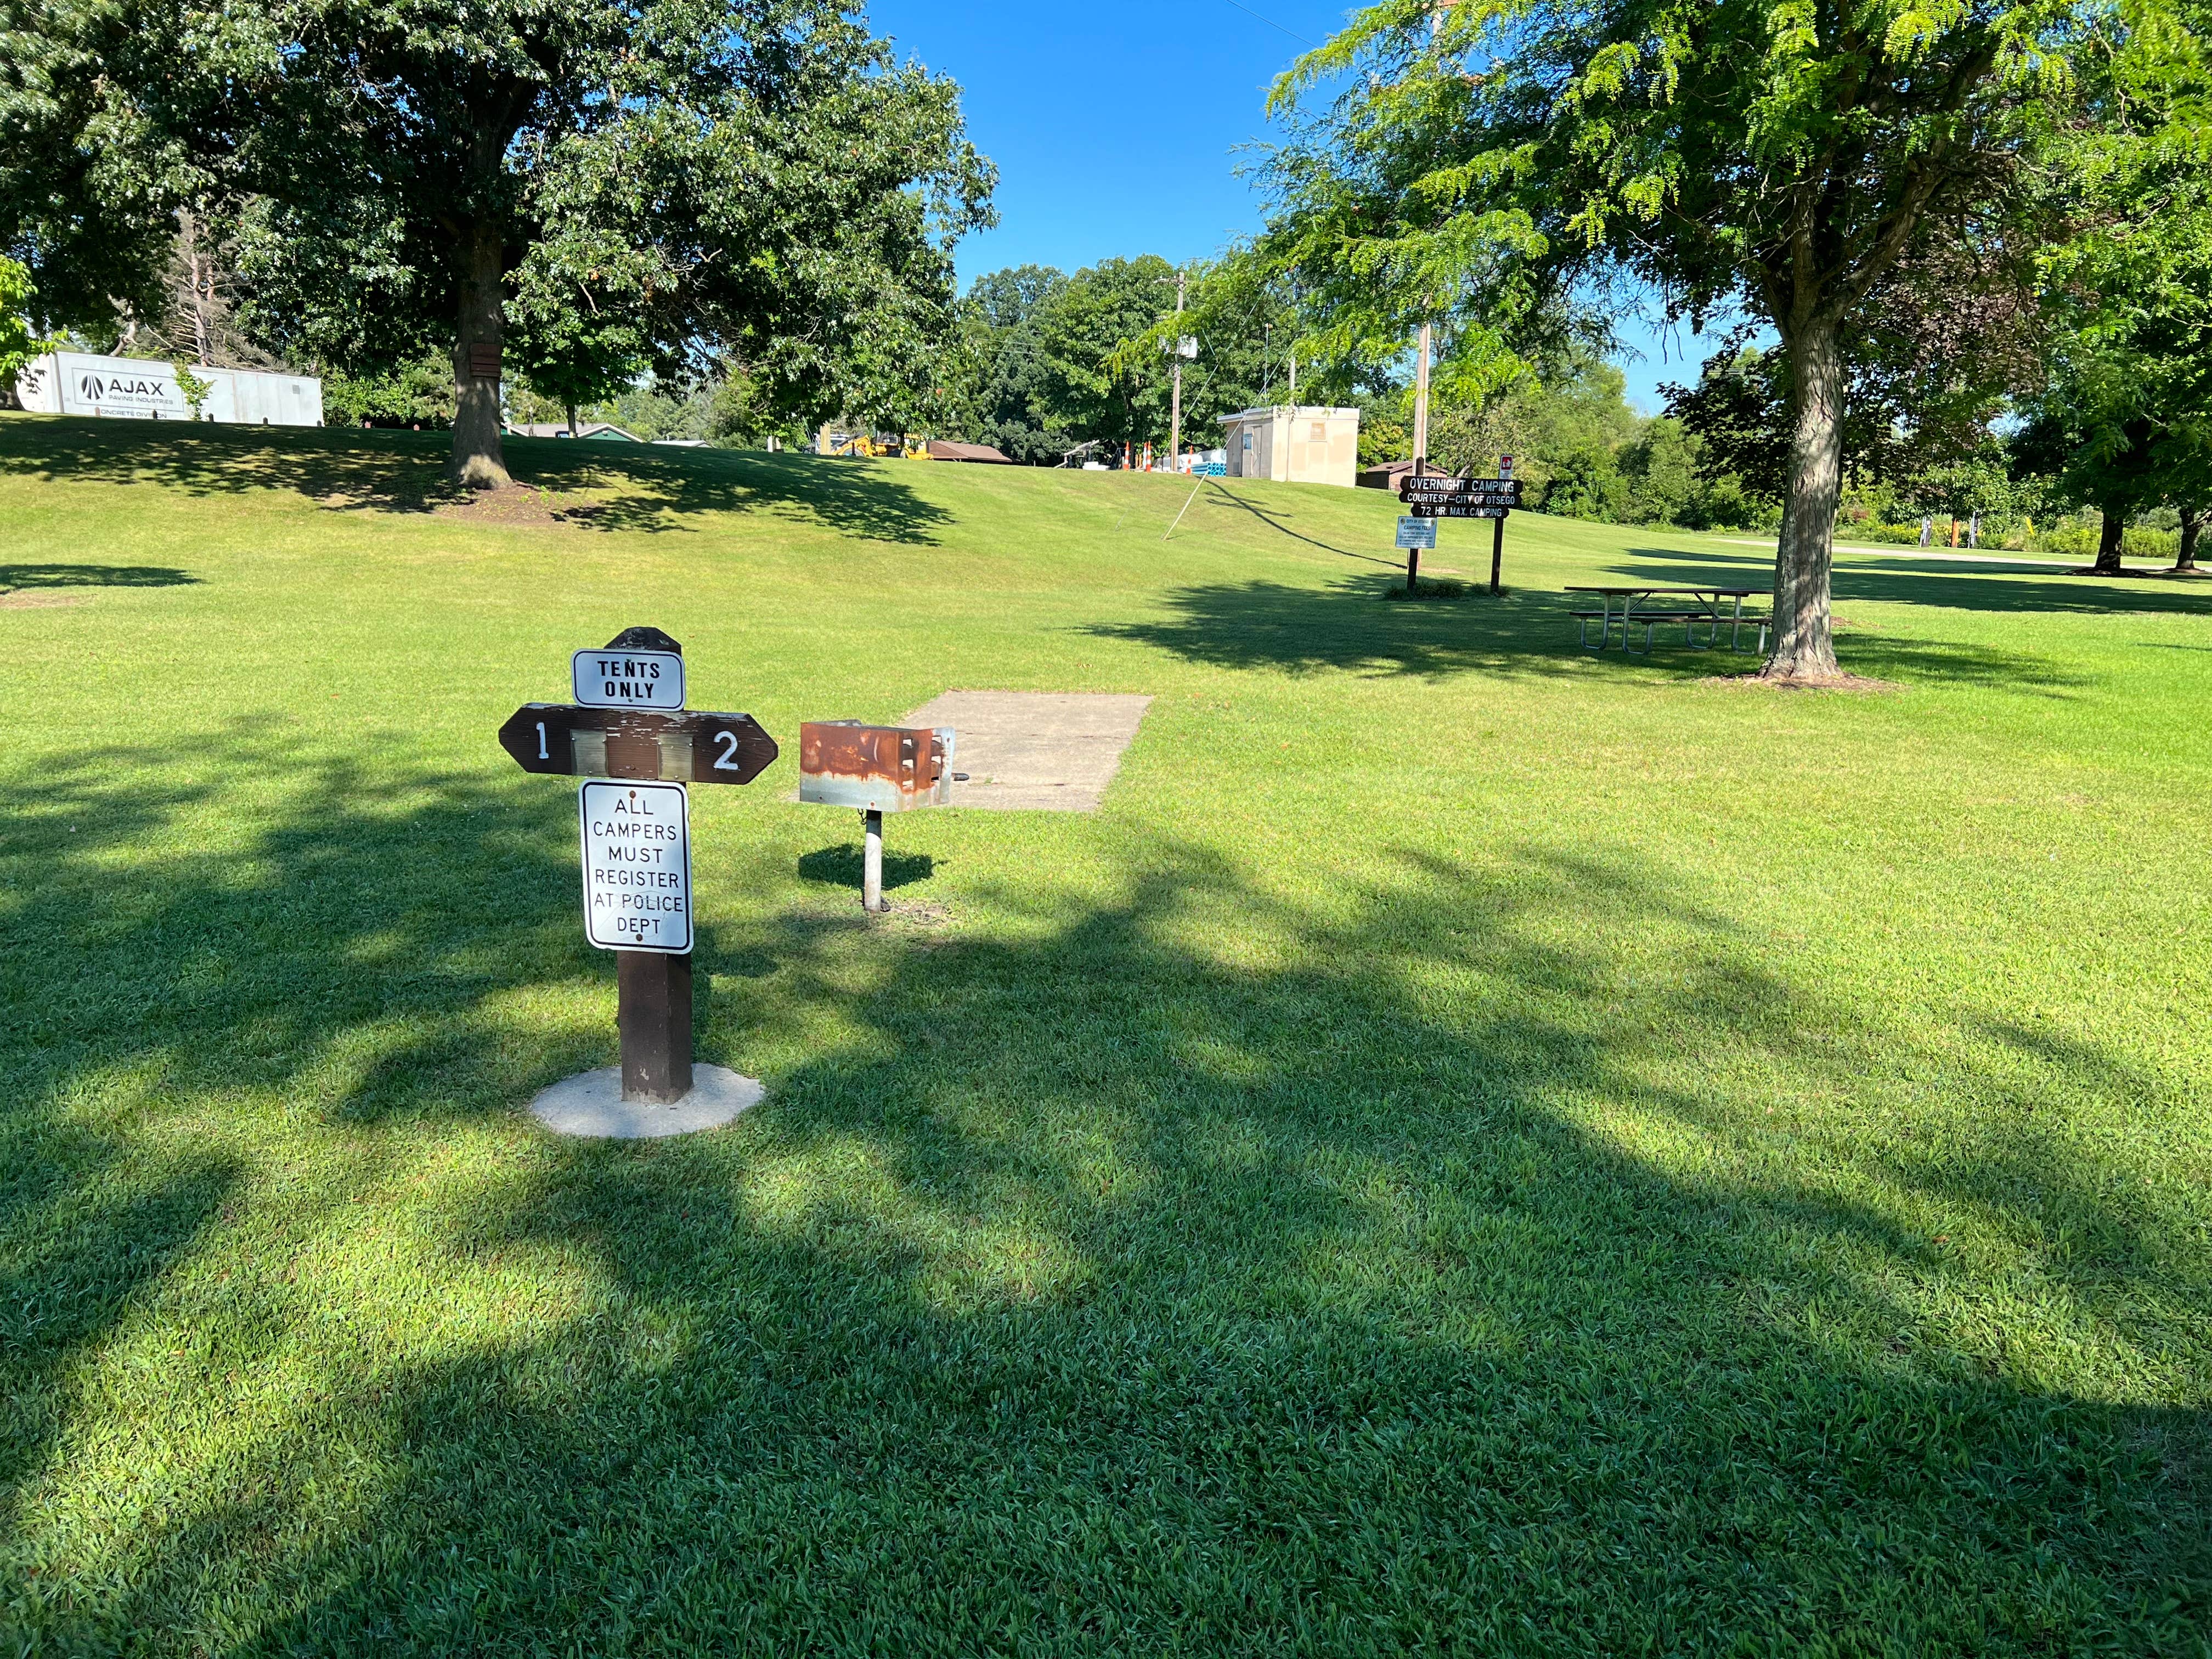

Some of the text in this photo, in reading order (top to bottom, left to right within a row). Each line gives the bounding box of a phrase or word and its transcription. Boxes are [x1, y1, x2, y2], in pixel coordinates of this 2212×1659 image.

[108, 379, 165, 396] AJAX
[1409, 477, 1514, 492] OVERNIGHT CAMPING
[1474, 495, 1485, 504] OF
[1486, 495, 1515, 505] OTSEGO
[1421, 506, 1502, 517] 72 HR. MAX. CAMPING
[597, 660, 660, 679] TENTS
[605, 680, 654, 699] ONLY
[535, 721, 549, 759] 1
[713, 730, 739, 770] 2
[614, 799, 653, 815] ALL
[594, 821, 676, 840] CAMPERS
[608, 846, 663, 863] MUST
[595, 869, 679, 888] REGISTER
[595, 893, 683, 912] AT POLICE
[618, 917, 660, 934] DEPT
